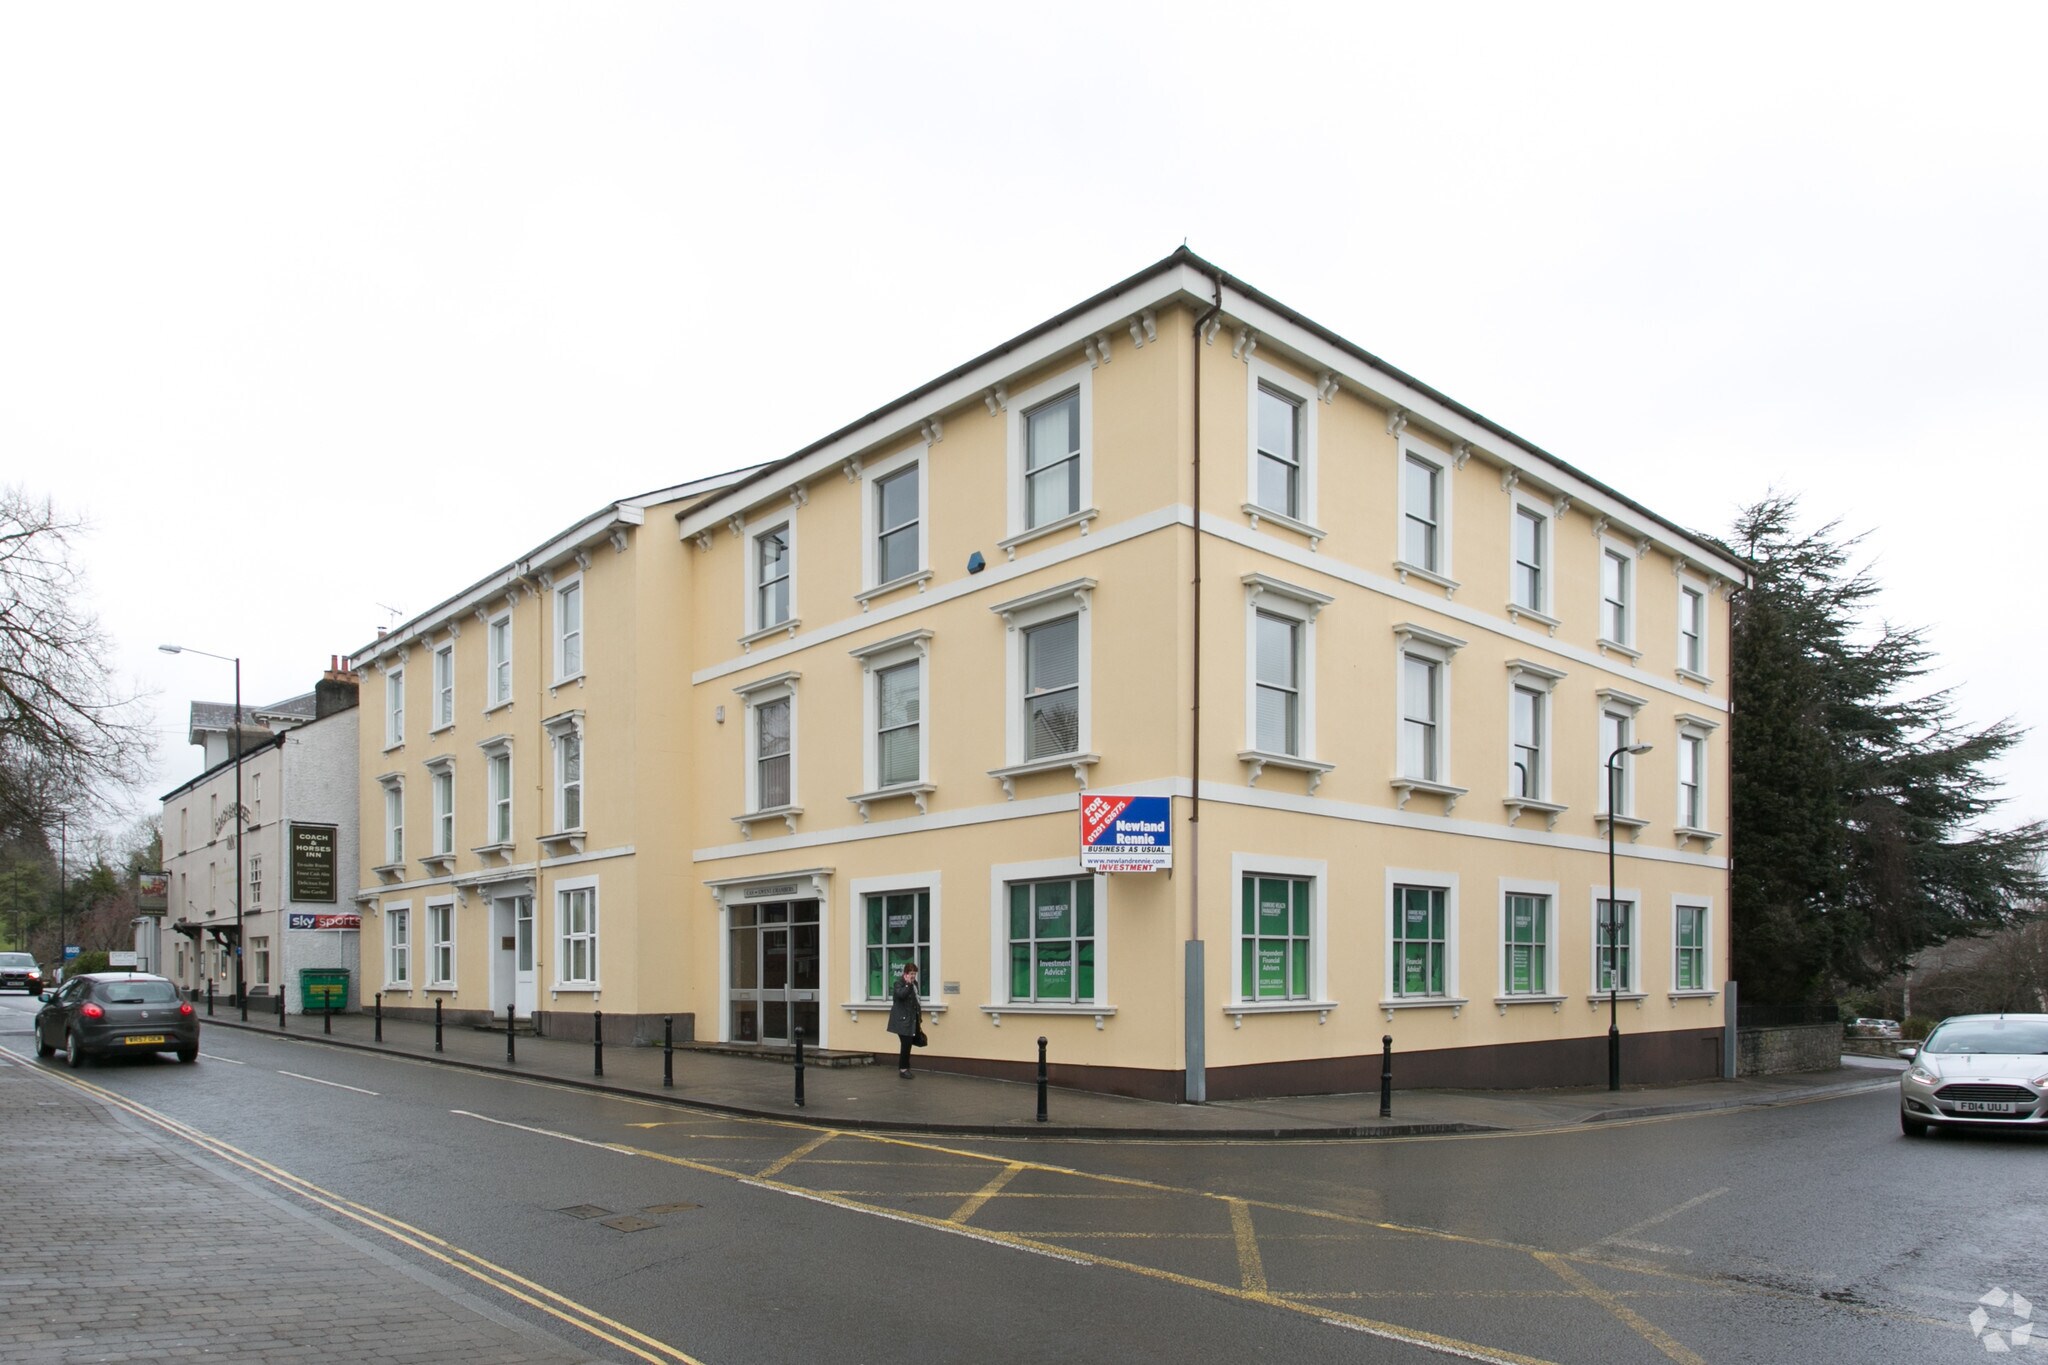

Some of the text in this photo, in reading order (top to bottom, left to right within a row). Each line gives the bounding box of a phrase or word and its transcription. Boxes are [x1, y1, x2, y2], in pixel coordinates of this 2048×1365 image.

[1084, 797, 1103, 816] FOR
[1089, 801, 1111, 825] SALE
[1087, 801, 1126, 842] 01291 626775
[1116, 820, 1165, 832] Newland
[1116, 833, 1155, 844] Rennie
[292, 915, 361, 928] sky sports
[1044, 968, 1067, 976] Advice?
[1961, 1102, 2009, 1111] FD14 UUJ
